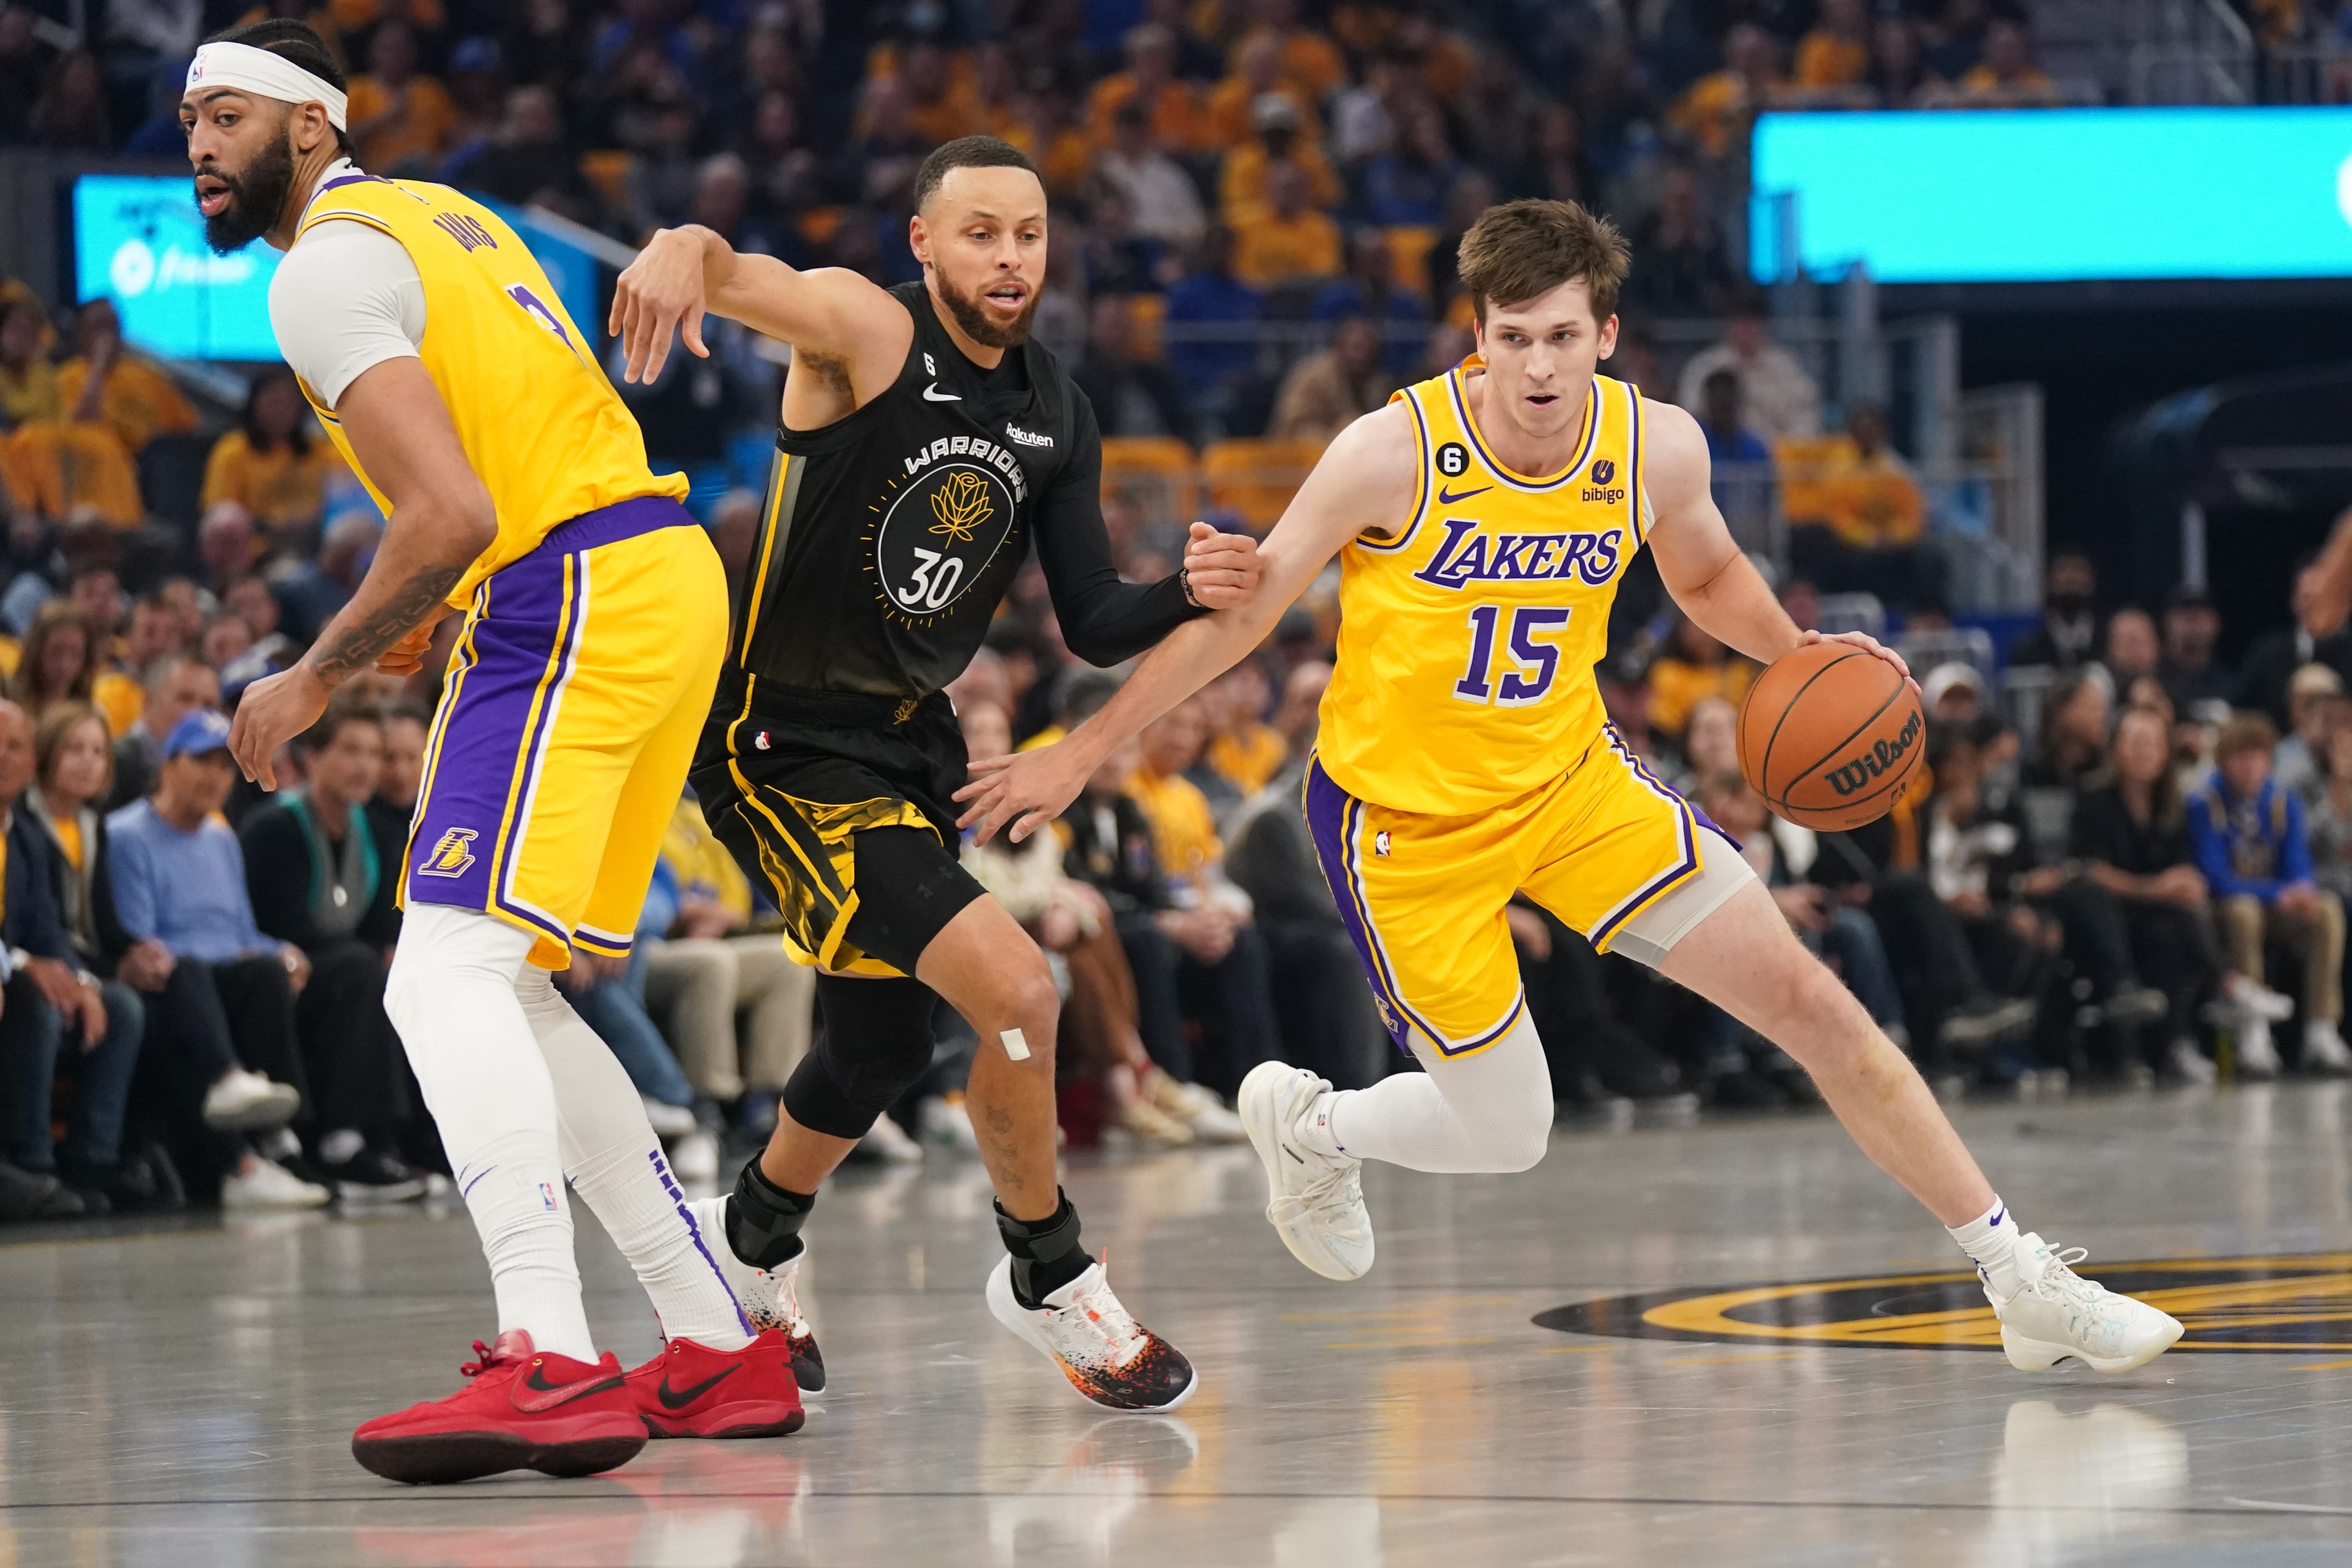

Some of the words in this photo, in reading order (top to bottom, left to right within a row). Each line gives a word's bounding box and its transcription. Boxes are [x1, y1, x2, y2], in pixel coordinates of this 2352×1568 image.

[433, 212, 497, 253] DAVIS
[924, 352, 936, 376] 6
[1006, 422, 1054, 447] Rakuten
[1444, 448, 1461, 472] 6
[904, 436, 1028, 503] WARRIORS
[1582, 487, 1624, 504] bibigo
[899, 547, 963, 608] 30
[1411, 517, 1624, 591] LAKERS
[1452, 604, 1573, 708] 15
[1824, 709, 1921, 797] Wilson
